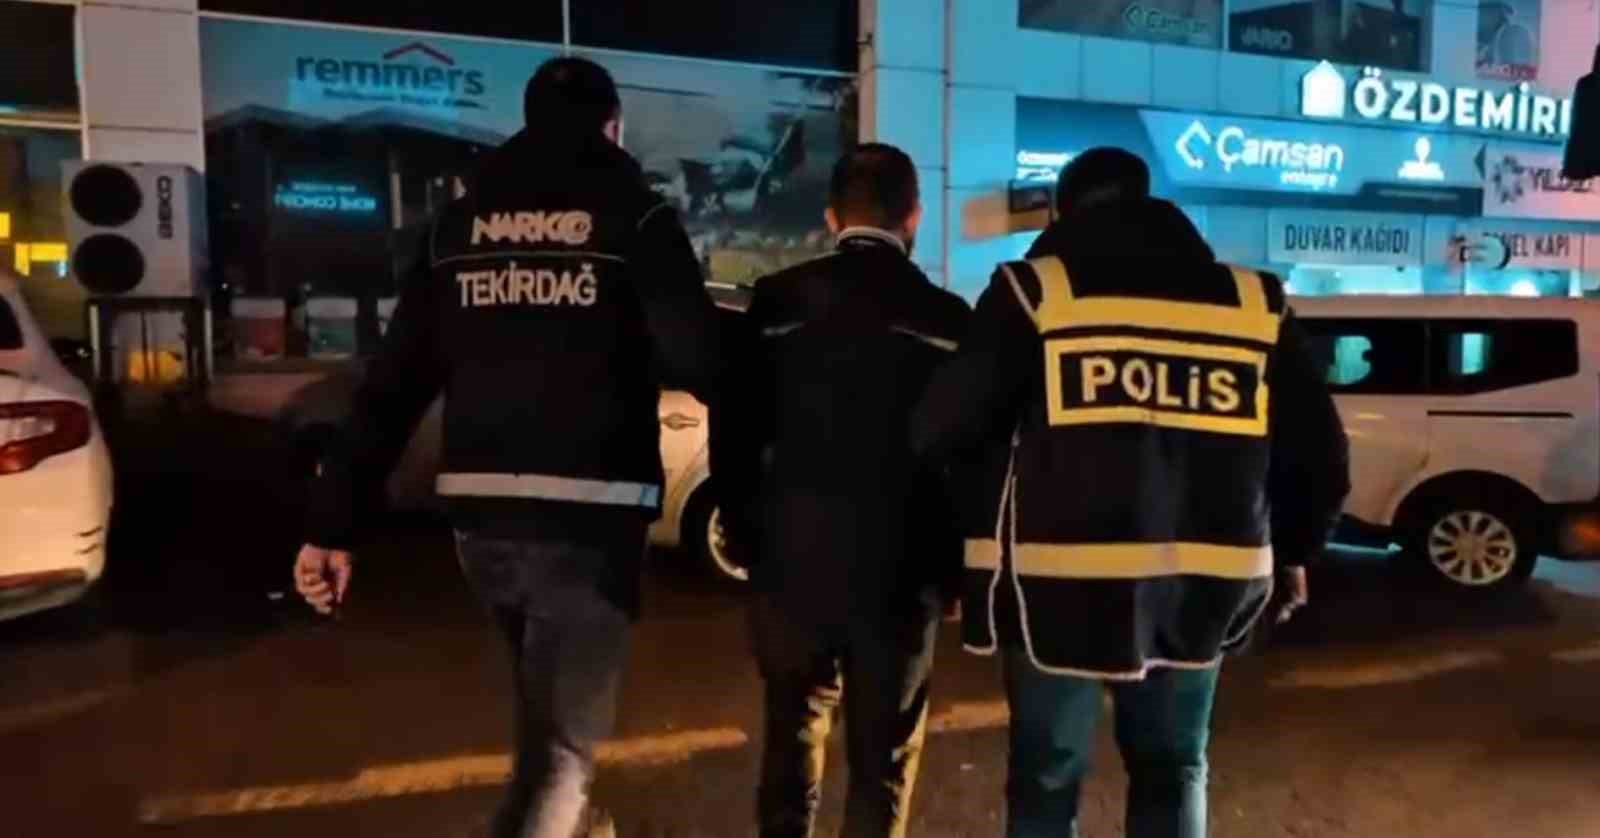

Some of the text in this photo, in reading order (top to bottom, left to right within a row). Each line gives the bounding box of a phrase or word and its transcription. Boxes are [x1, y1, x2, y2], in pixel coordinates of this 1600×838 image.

[296, 56, 485, 95] remmers
[1284, 223, 1345, 252] DUVAR
[1535, 233, 1570, 258] KAPI
[456, 260, 598, 308] TEKİRDAĞ
